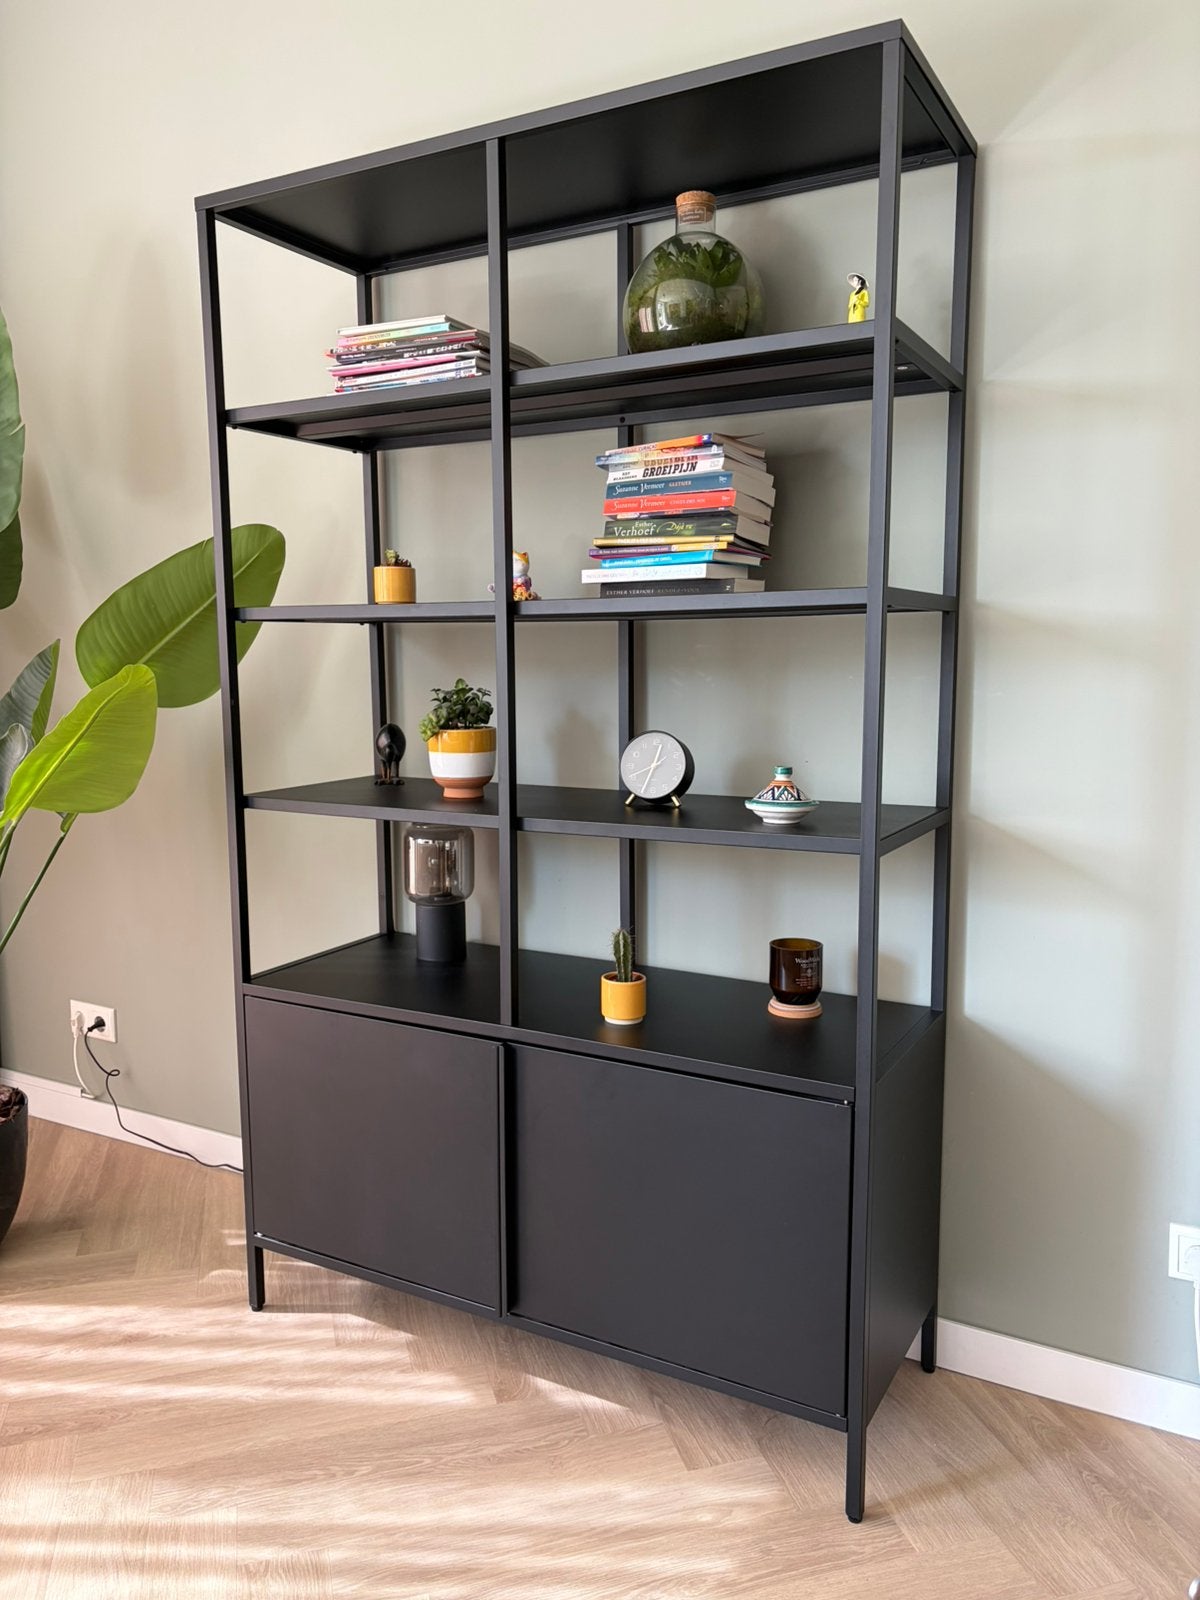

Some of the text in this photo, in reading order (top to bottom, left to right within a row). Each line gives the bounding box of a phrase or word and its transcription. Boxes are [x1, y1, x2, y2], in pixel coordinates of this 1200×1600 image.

[643, 461, 698, 478] GROEIPIJN
[613, 484, 639, 495] Suzanne
[640, 482, 665, 494] Vermeer
[613, 501, 639, 510] Suzanne
[640, 498, 666, 509] Vermeer
[613, 524, 657, 537] Verhoef
